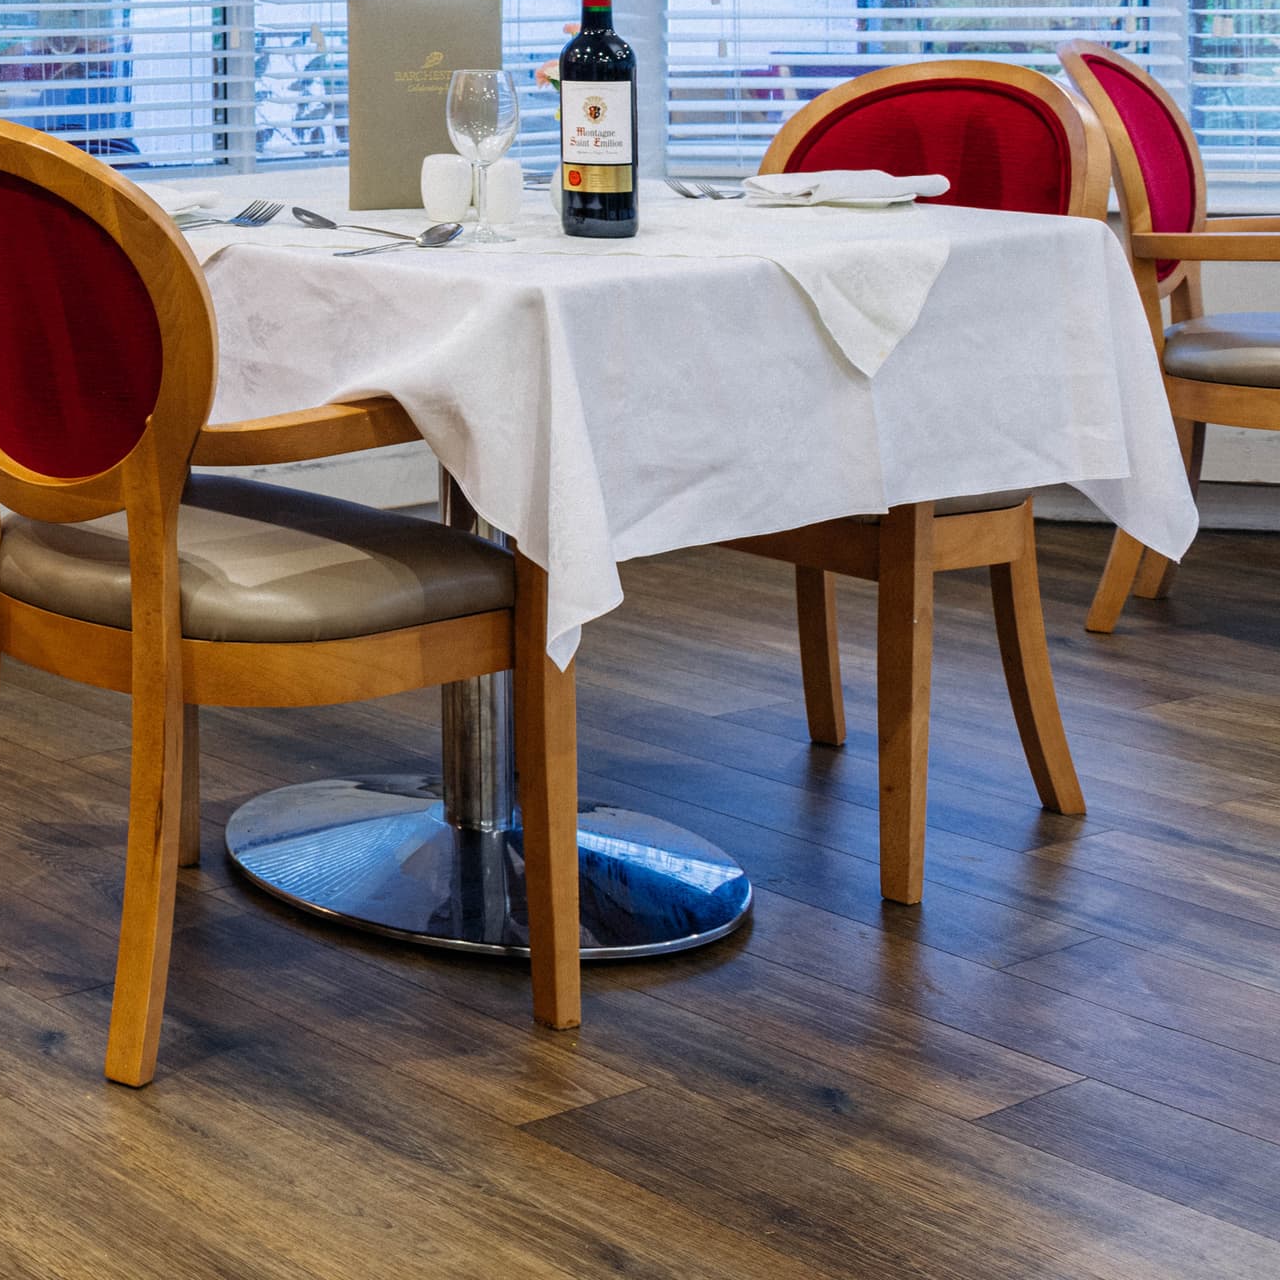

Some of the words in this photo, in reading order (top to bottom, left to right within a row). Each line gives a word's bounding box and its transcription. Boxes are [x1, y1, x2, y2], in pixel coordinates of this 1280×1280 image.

[394, 70, 453, 81] BARCHEST
[576, 127, 616, 138] Montagne
[570, 136, 590, 147] Saint
